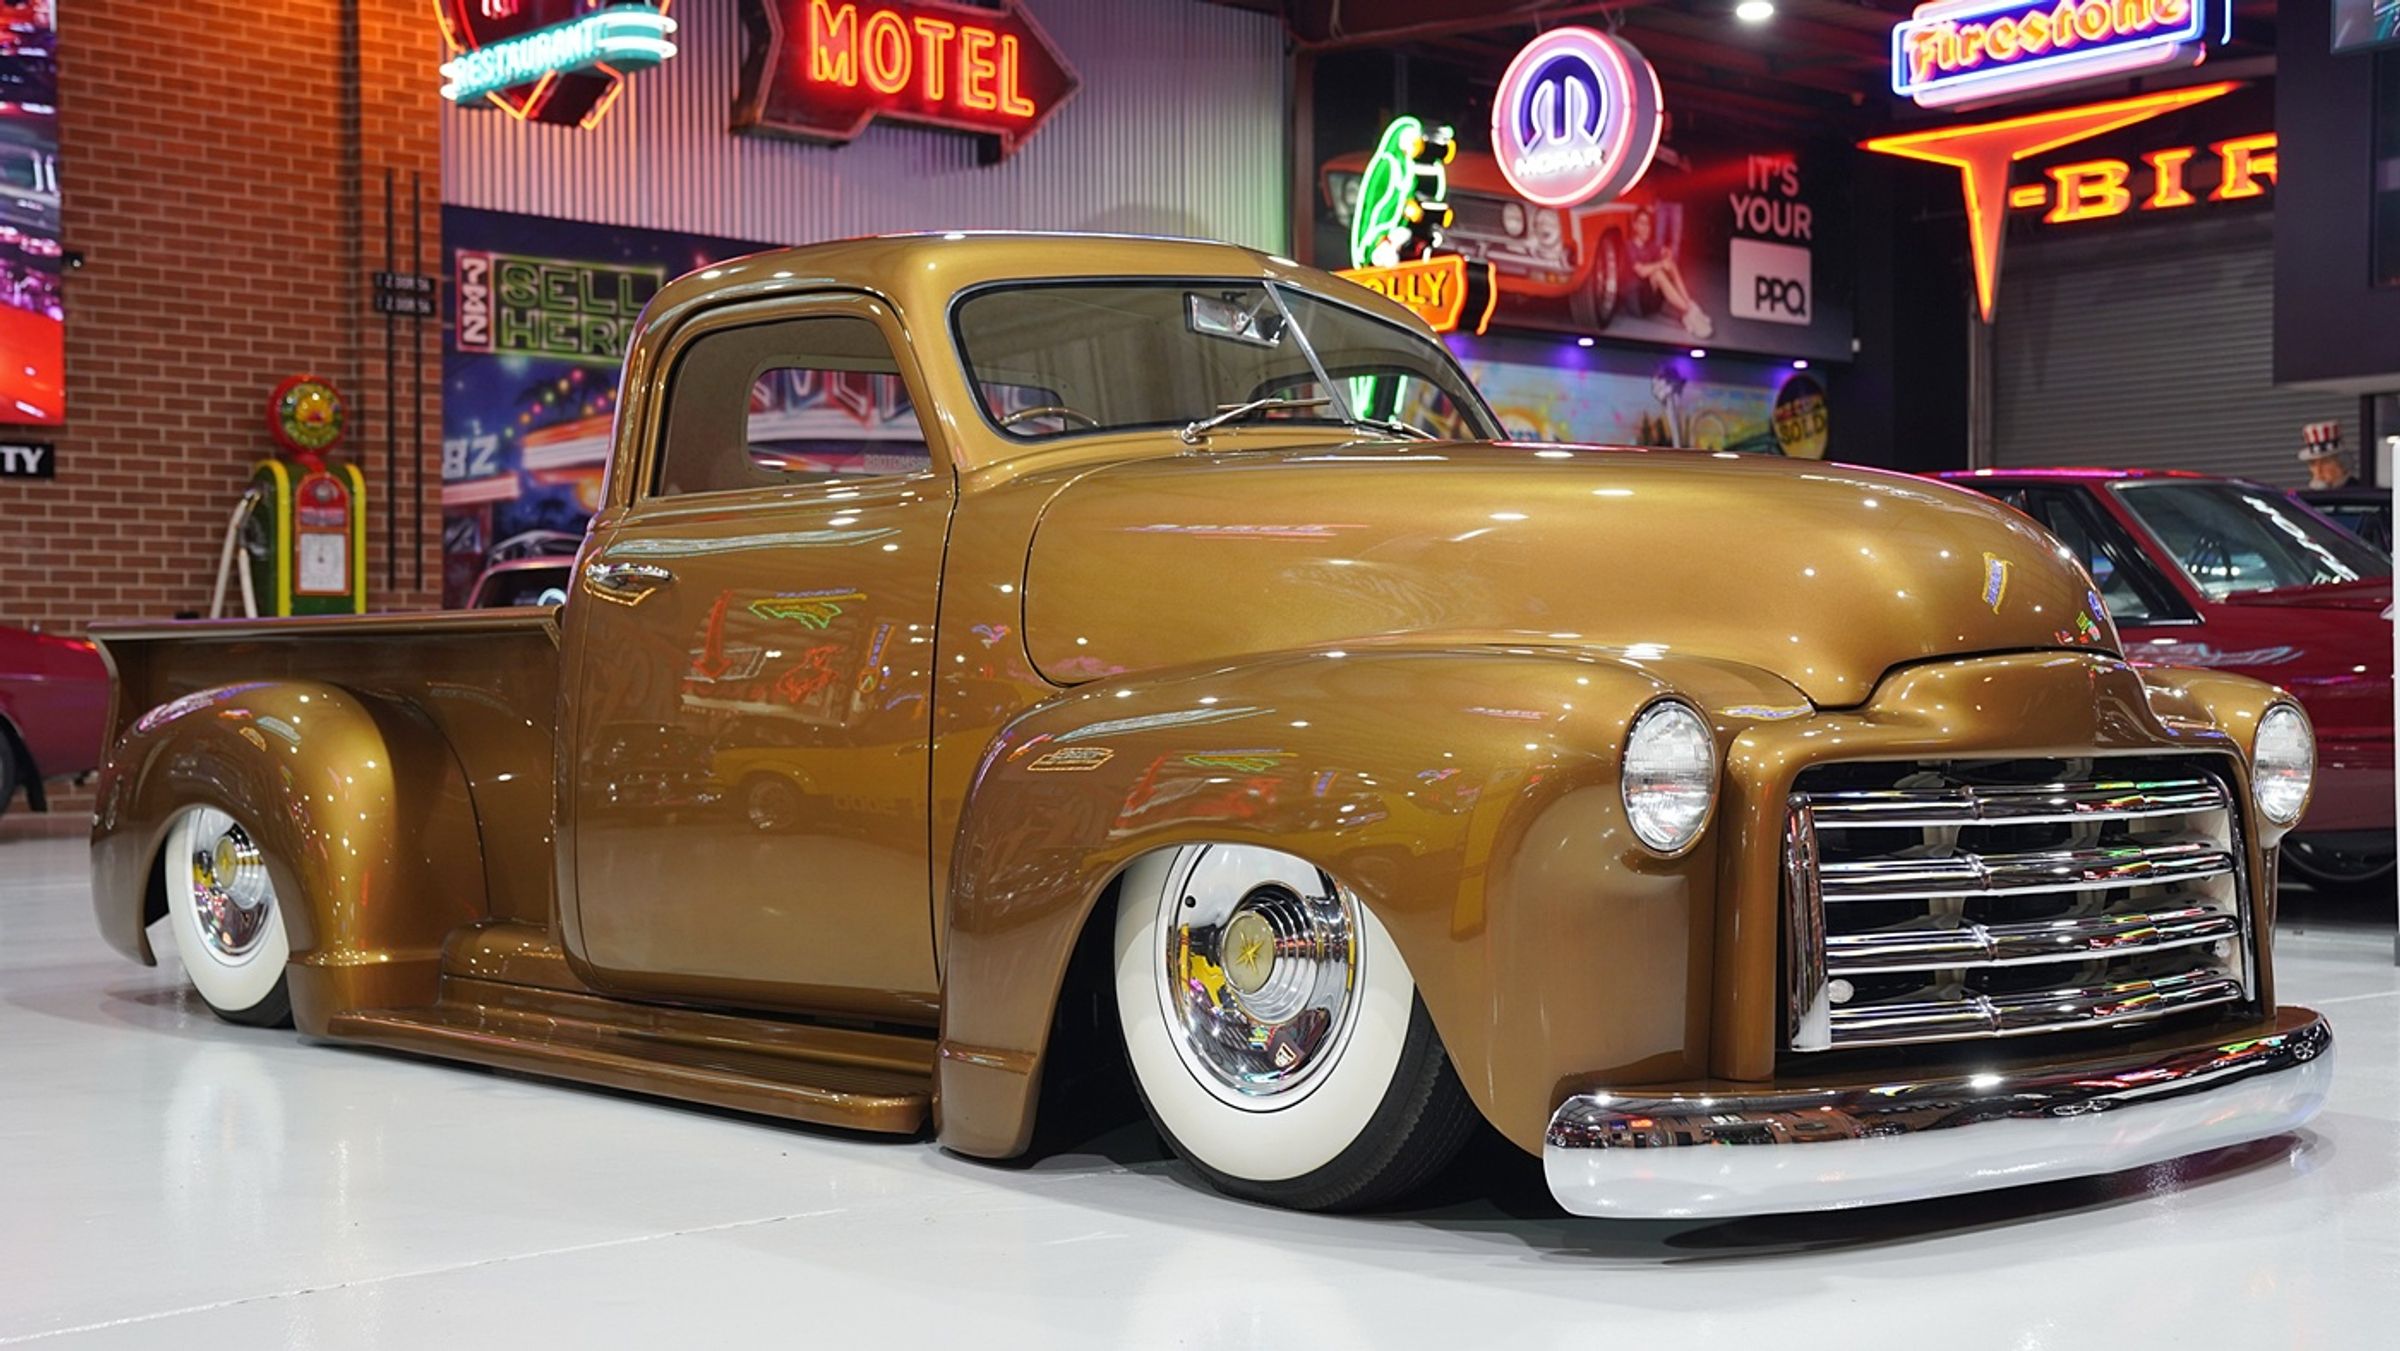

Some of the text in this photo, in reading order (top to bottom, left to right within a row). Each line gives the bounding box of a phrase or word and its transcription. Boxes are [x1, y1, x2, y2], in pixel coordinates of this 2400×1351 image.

[453, 18, 601, 93] RESTAURANT
[808, 0, 1036, 118] MOTEL
[1904, 0, 2191, 84] Firestone
[1748, 155, 1799, 197] IT'S
[1729, 193, 1813, 241] YOUR
[501, 262, 646, 316] SELL
[1362, 269, 1448, 307] OLLY
[1755, 275, 1807, 317] PPQ
[0, 446, 44, 474] TY
